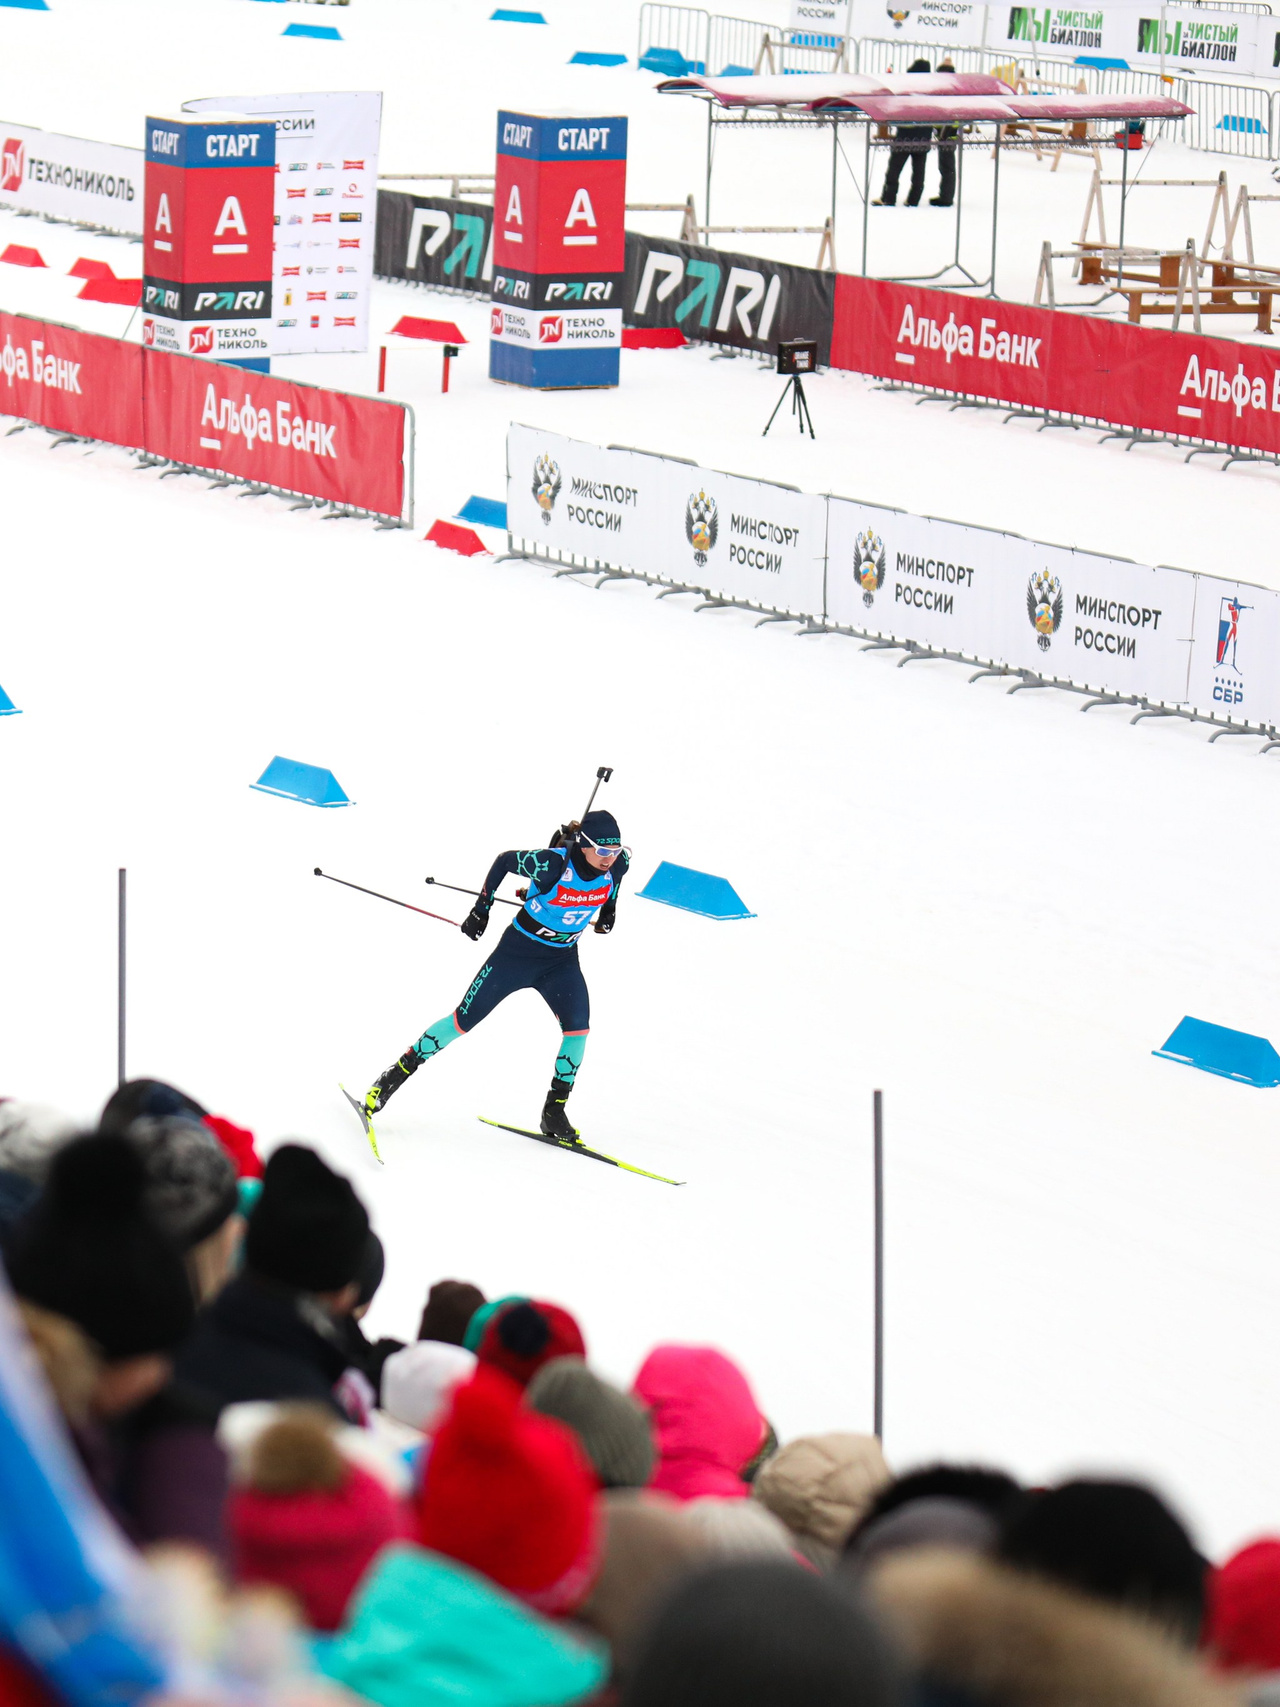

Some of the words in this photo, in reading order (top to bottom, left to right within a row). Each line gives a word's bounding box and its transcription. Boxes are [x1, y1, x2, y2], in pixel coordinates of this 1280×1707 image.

[797, 6, 836, 19] РОССИИ
[917, 15, 959, 28] РОССИИ
[1057, 9, 1104, 30] ЧИСТЫЙ
[1050, 27, 1102, 48] БИАТЛОН
[1188, 21, 1239, 43] ЧИСТЫЙ
[1181, 40, 1237, 62] БИАТЛОН
[152, 129, 179, 156] СТАРТ
[206, 133, 260, 157] СТАРТ
[503, 122, 533, 149] СТАРТ
[558, 127, 610, 151] СТАРТ
[28, 158, 135, 202] ТЕХНОНИКОЛЬ
[145, 286, 179, 310] PARI
[494, 275, 530, 299] PARI
[545, 281, 613, 302] PARI
[634, 251, 781, 341] PARI
[194, 291, 265, 311] PARI
[156, 324, 175, 337] ТЕХНО
[505, 313, 526, 326] ТЕХНО
[566, 318, 605, 328] ТЕХНО
[156, 338, 180, 350] НИКОЛЬ
[217, 328, 257, 338] ТЕХНО
[505, 326, 531, 339] НИКОЛЬ
[567, 329, 615, 340] НИКОЛЬ
[897, 303, 974, 364] Альфа
[978, 317, 1042, 369] Банк
[218, 339, 268, 350] НИКОЛЬ
[31, 340, 83, 395] Банк
[1179, 353, 1267, 418] Альфа
[201, 383, 273, 450] Альфа
[276, 400, 337, 459] Банк
[570, 476, 638, 508] МИНСПОРТ
[567, 503, 622, 533] РОССИИ
[730, 513, 800, 548] МИНСПОРТ
[729, 542, 783, 574] РОССИИ
[896, 552, 975, 588] МИНСПОРТ
[895, 582, 954, 615] РОССИИ
[1076, 593, 1162, 630] МИНСПОРТ
[1074, 626, 1136, 659] РОССИИ
[1212, 685, 1244, 705] СБР
[530, 898, 542, 913] 57
[560, 893, 587, 903] Альфа
[588, 893, 606, 902] Банк
[561, 910, 592, 925] 57
